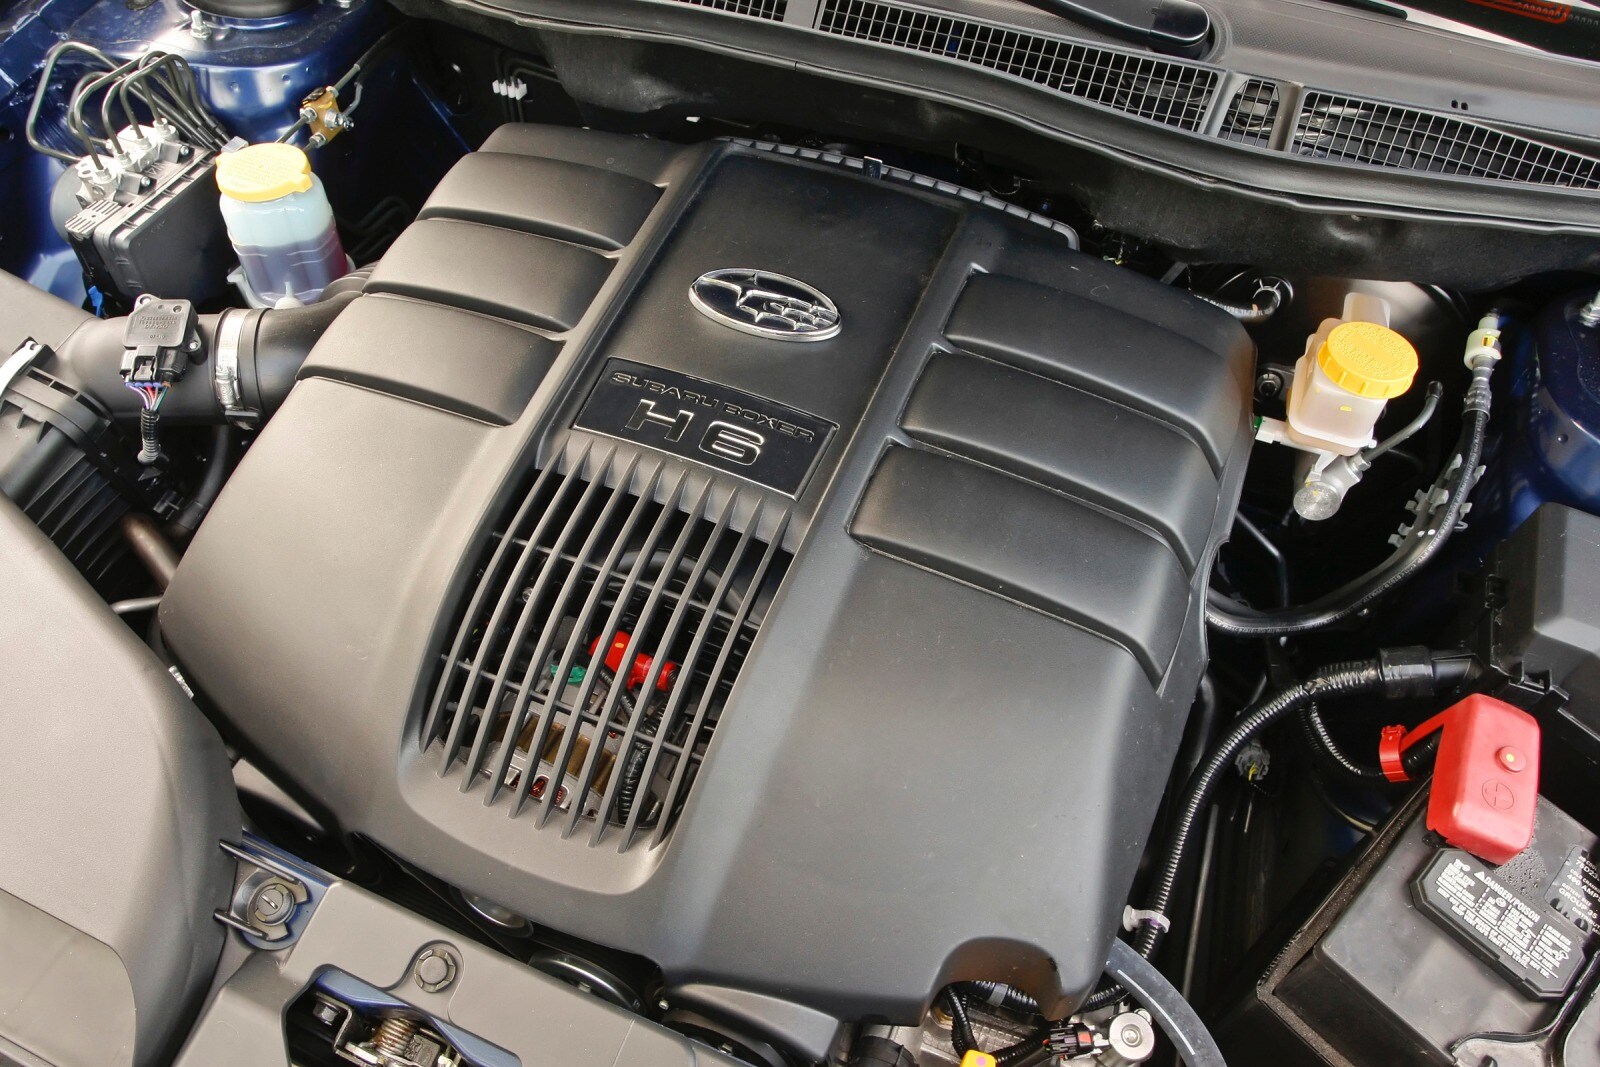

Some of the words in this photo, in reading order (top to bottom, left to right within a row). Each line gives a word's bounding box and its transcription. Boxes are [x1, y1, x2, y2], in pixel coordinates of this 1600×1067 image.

[612, 372, 719, 408] SUBARU
[722, 402, 815, 443] BOXER
[624, 398, 765, 466] H6
[1569, 867, 1583, 880] COLD
[1483, 875, 1540, 923] DANGER/POISON
[1557, 886, 1588, 912] GROUP
[1586, 908, 1598, 920] 35
